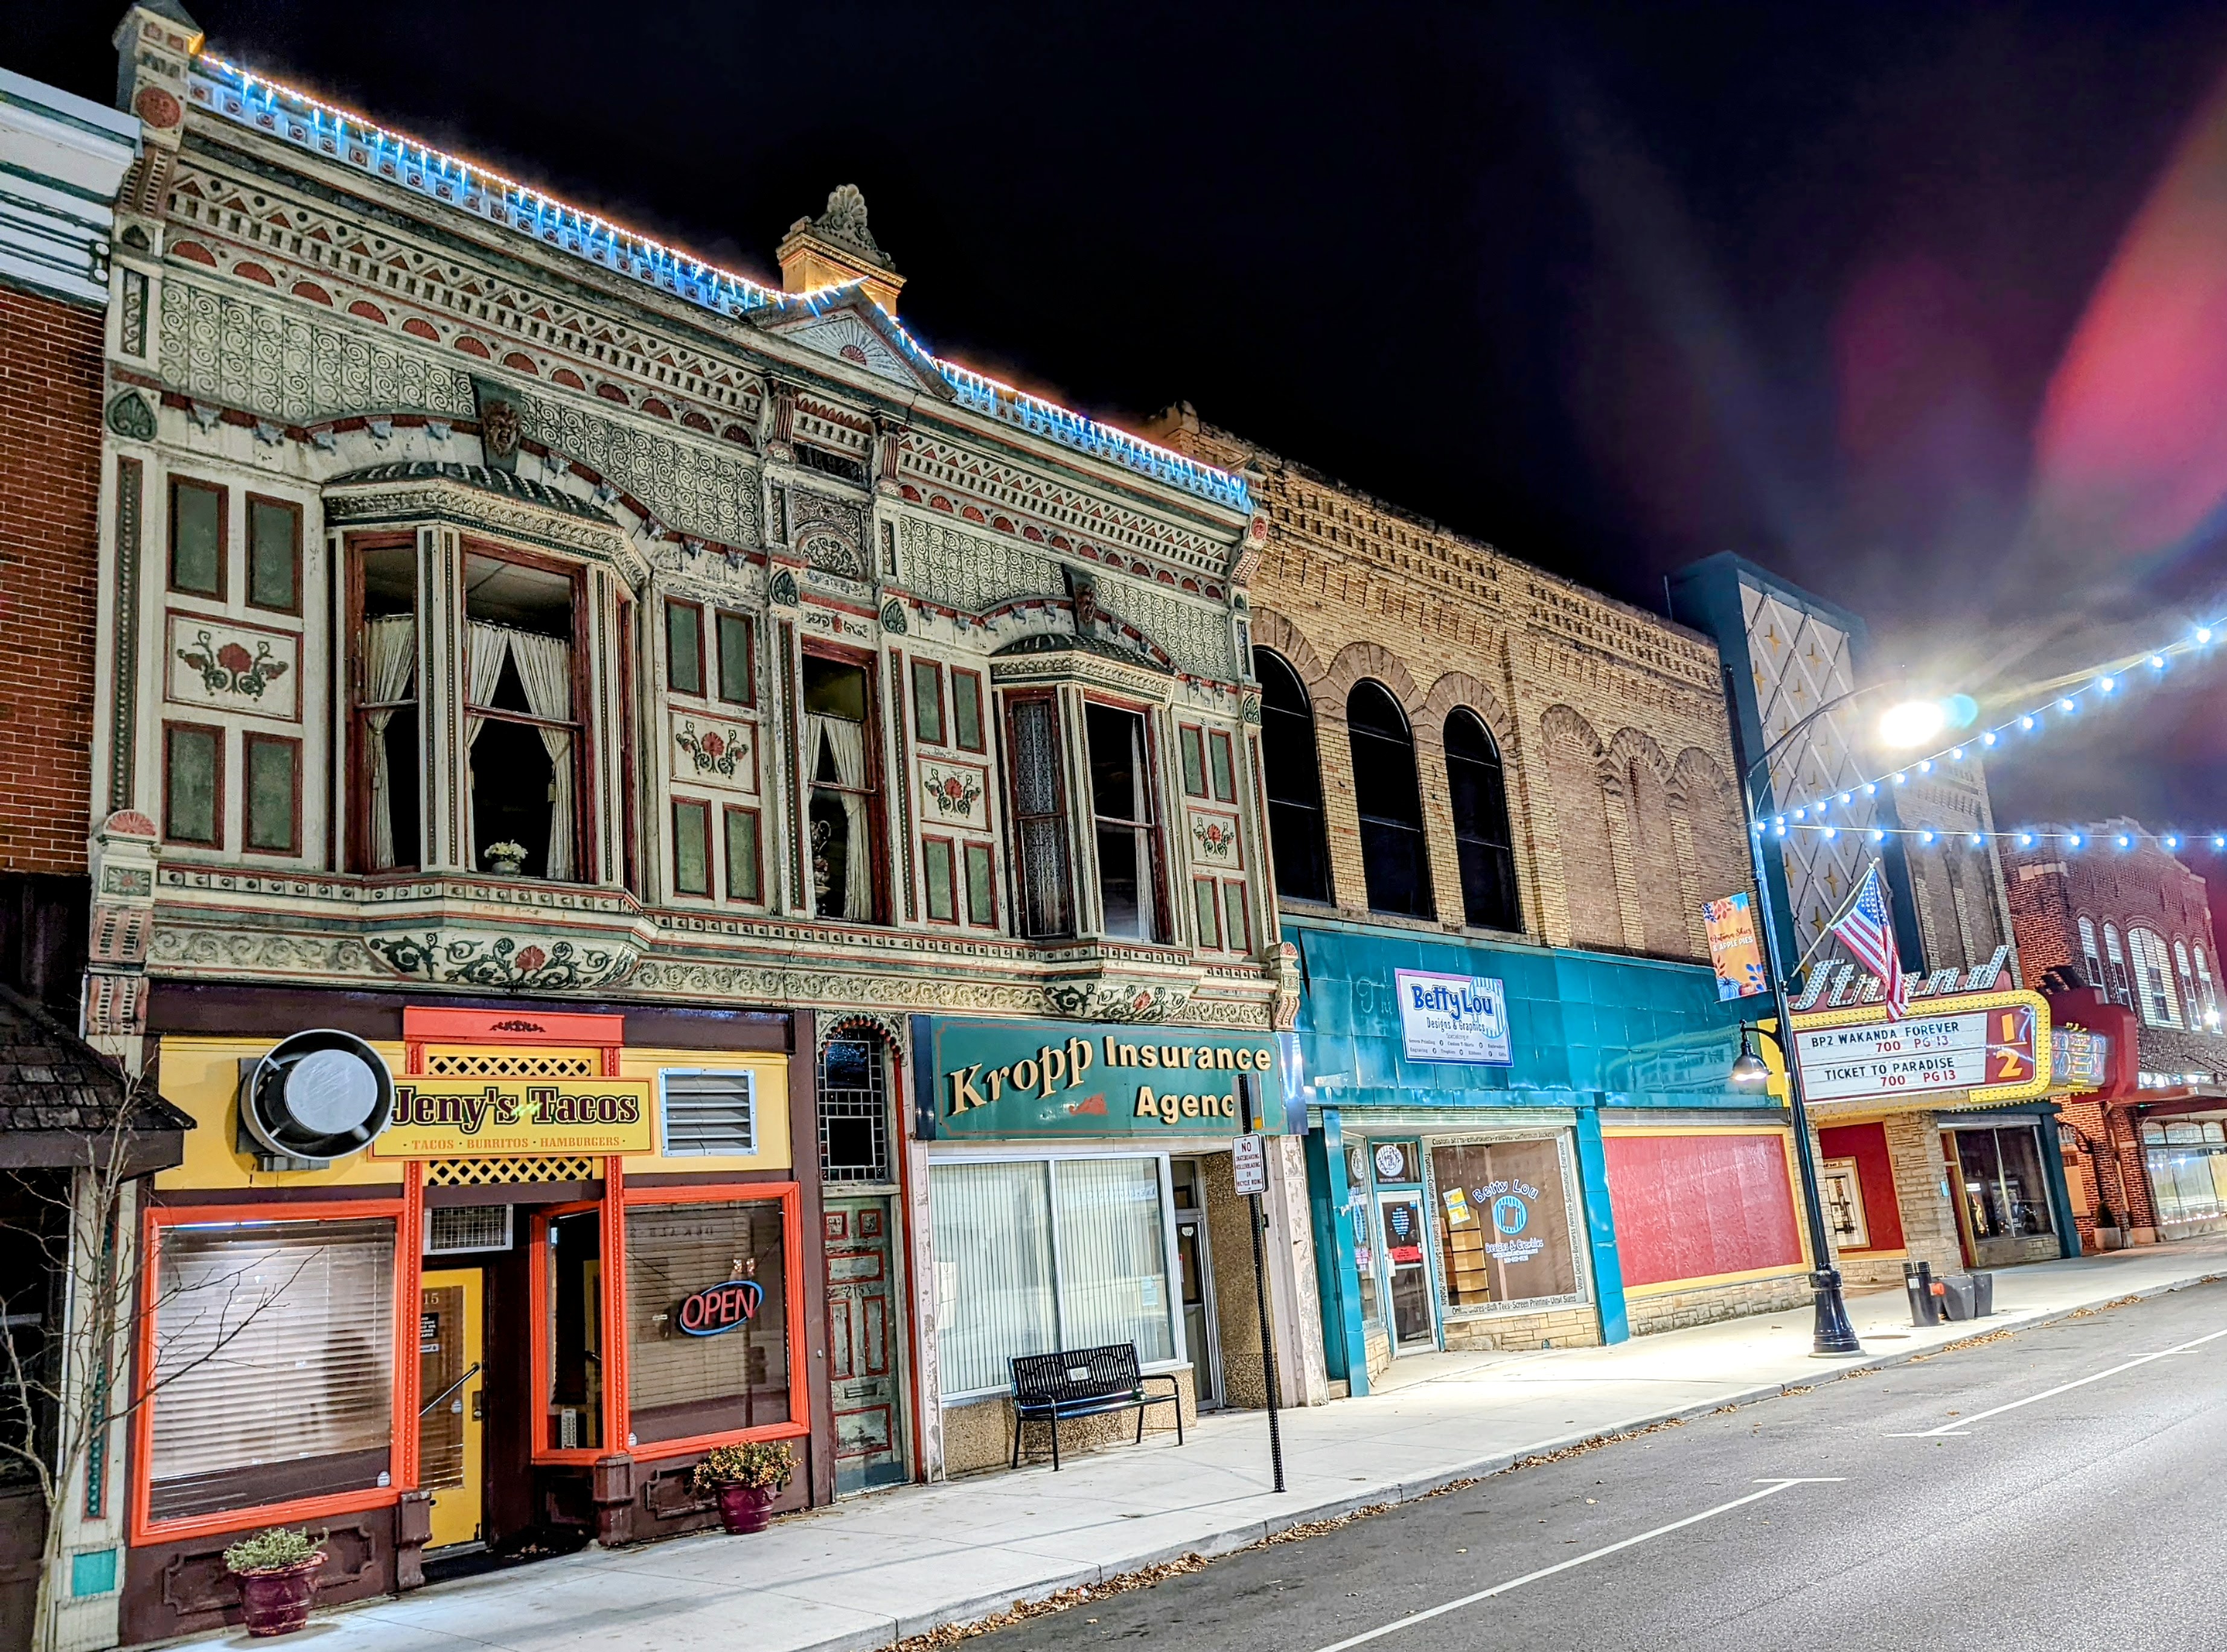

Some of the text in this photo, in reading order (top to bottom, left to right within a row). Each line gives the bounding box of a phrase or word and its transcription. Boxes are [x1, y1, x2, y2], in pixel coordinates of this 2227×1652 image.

[1719, 939, 1738, 950] APPLE
[1739, 936, 1754, 945] PIES
[1410, 984, 1494, 1021] Betty Lou
[1426, 1016, 1486, 1033] Designs & Graphics
[1812, 1022, 1960, 1047] BP2 WAKANDA FOREVER
[2001, 1013, 2016, 1043] 1
[1876, 1041, 1901, 1053] 700
[1914, 1037, 1931, 1048] PG
[1824, 1057, 1954, 1080] TICKET TO PARADISE
[1995, 1050, 2024, 1078] 2
[948, 1036, 1272, 1117] Kropp Insurance
[1880, 1070, 1956, 1087] 700 PG 13
[391, 1086, 640, 1134] Jeny's Tacos
[1134, 1086, 1236, 1125] Agenc
[412, 1137, 620, 1150] TACOS BURRITOS HAMBURGERS
[1241, 1142, 1251, 1152] NO
[1236, 1153, 1259, 1162] SKATEBOARDING
[1472, 1179, 1539, 1203] Betty Lou
[1564, 1172, 1572, 1203] Sublimation
[1436, 1251, 1445, 1284] Sportswear
[683, 1287, 755, 1328] OPEN
[1498, 1302, 1510, 1310] Tees
[1512, 1300, 1529, 1309] Screen
